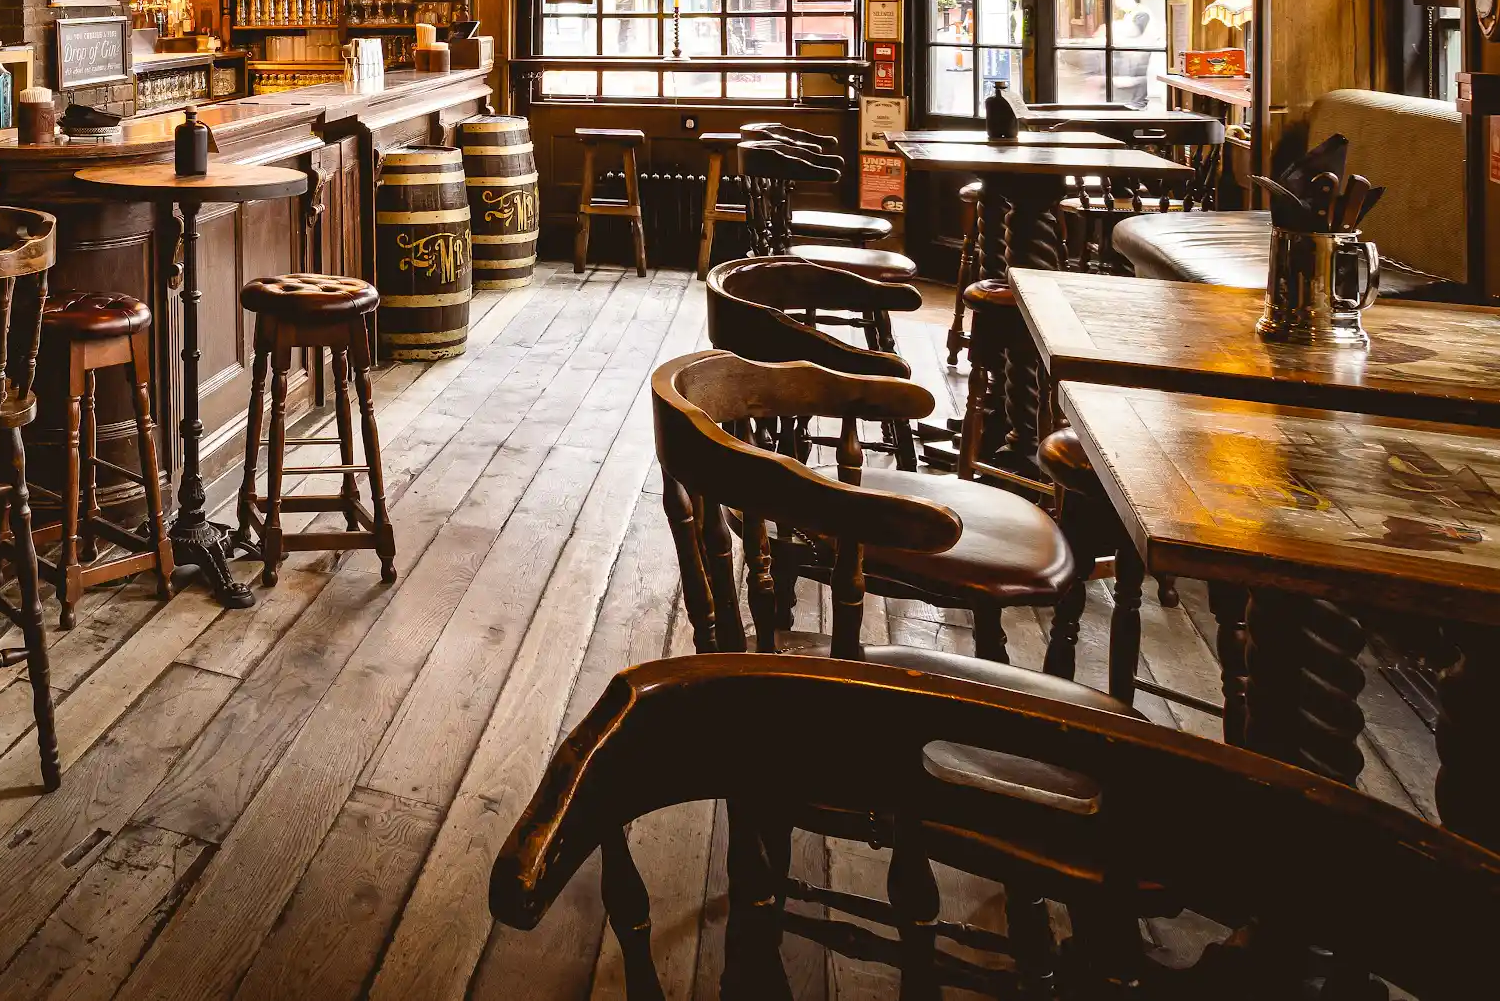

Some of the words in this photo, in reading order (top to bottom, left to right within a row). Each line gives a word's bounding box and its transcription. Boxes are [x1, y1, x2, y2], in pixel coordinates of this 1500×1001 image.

[64, 42, 86, 66] Drop
[89, 41, 101, 65] of
[862, 156, 901, 167] UNDER
[862, 164, 882, 172] 25?
[887, 200, 904, 211] 25
